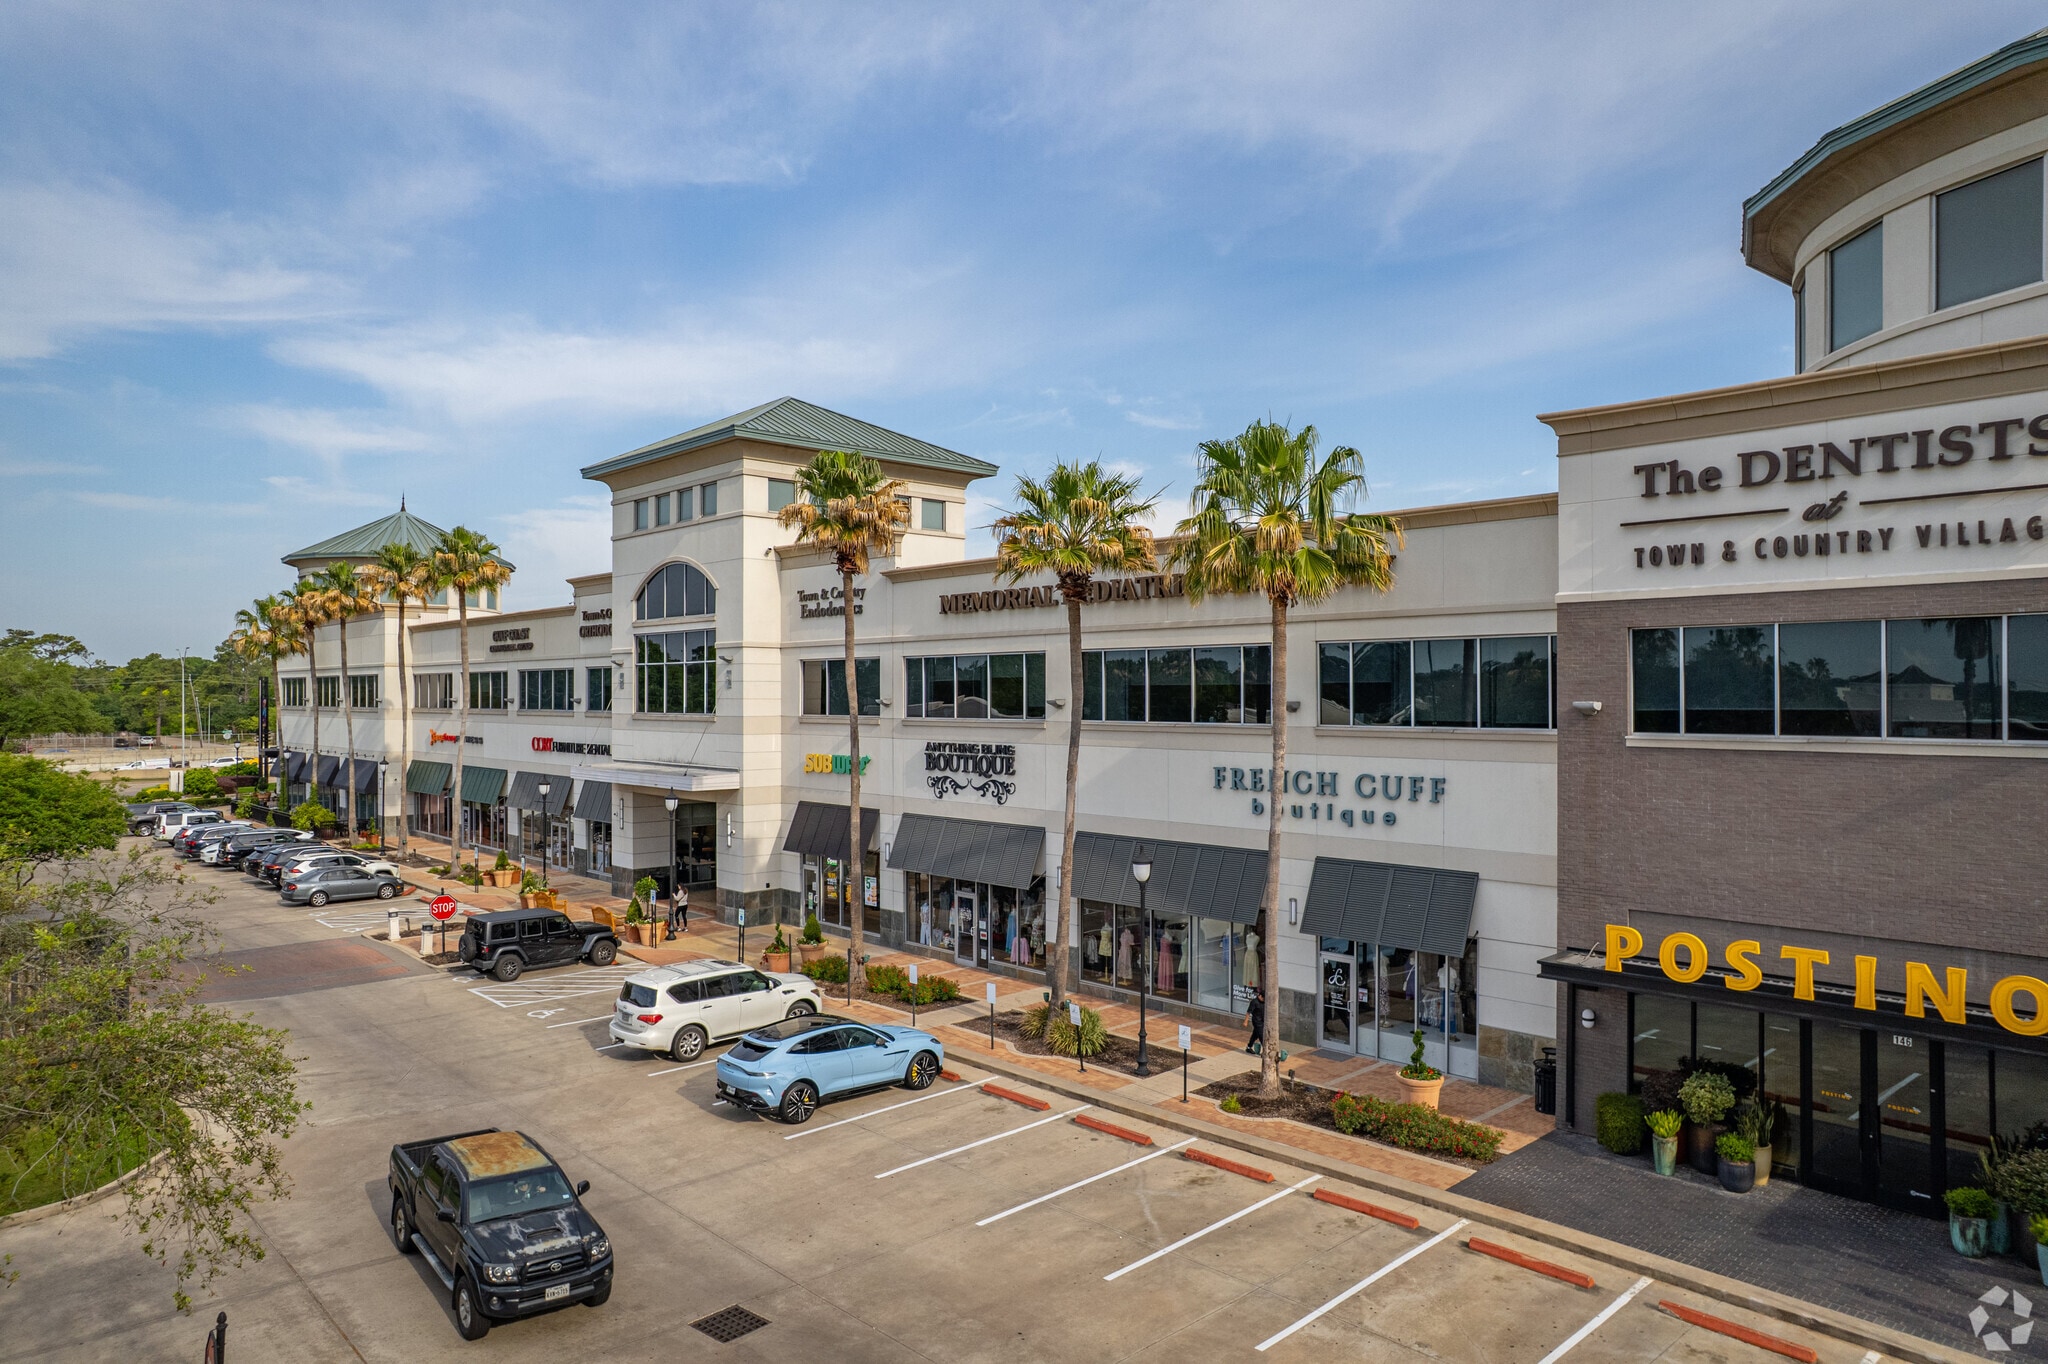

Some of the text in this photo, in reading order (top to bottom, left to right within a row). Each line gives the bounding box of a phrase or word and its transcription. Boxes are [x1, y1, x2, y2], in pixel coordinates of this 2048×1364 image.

[1634, 459, 1722, 497] The
[1802, 490, 1847, 522] at
[1634, 542, 1705, 568] TOWN
[1722, 540, 1737, 562] &
[1755, 527, 1894, 559] COUNTRY
[797, 589, 819, 602] Town
[820, 588, 829, 600] &
[939, 585, 1058, 614] MEMORIAL
[925, 742, 1016, 755] ANYTHING BLING
[924, 753, 1016, 778] BOUTIQUE
[1355, 773, 1446, 803] CUFF
[1251, 798, 1397, 828] butique
[432, 902, 454, 913] STOP
[1604, 923, 2048, 1037] POSTINO
[1894, 1035, 1913, 1047] 146
